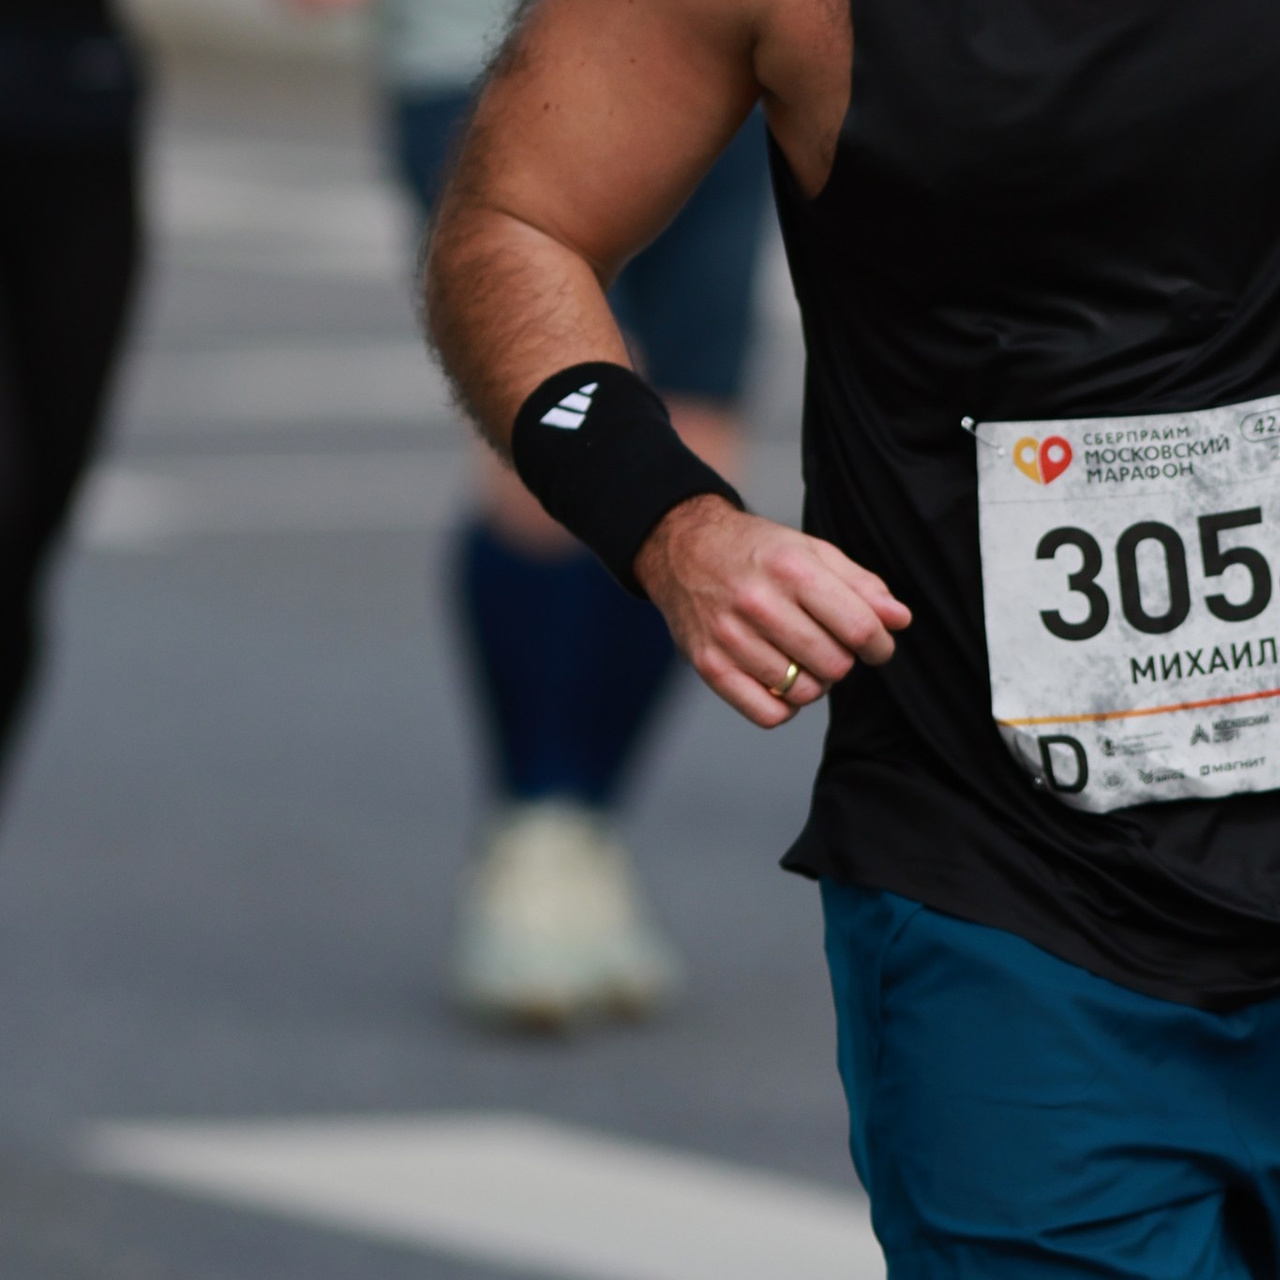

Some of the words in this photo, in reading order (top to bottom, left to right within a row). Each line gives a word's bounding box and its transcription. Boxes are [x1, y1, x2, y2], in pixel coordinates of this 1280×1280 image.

[1083, 426, 1190, 446] СБЕРПРАЙМ
[1084, 434, 1231, 465] МОСКОВСКИЙ
[1087, 461, 1195, 484] МАРАФОН
[1130, 636, 1278, 684] МИХАИЛ
[1038, 734, 1089, 794] D
